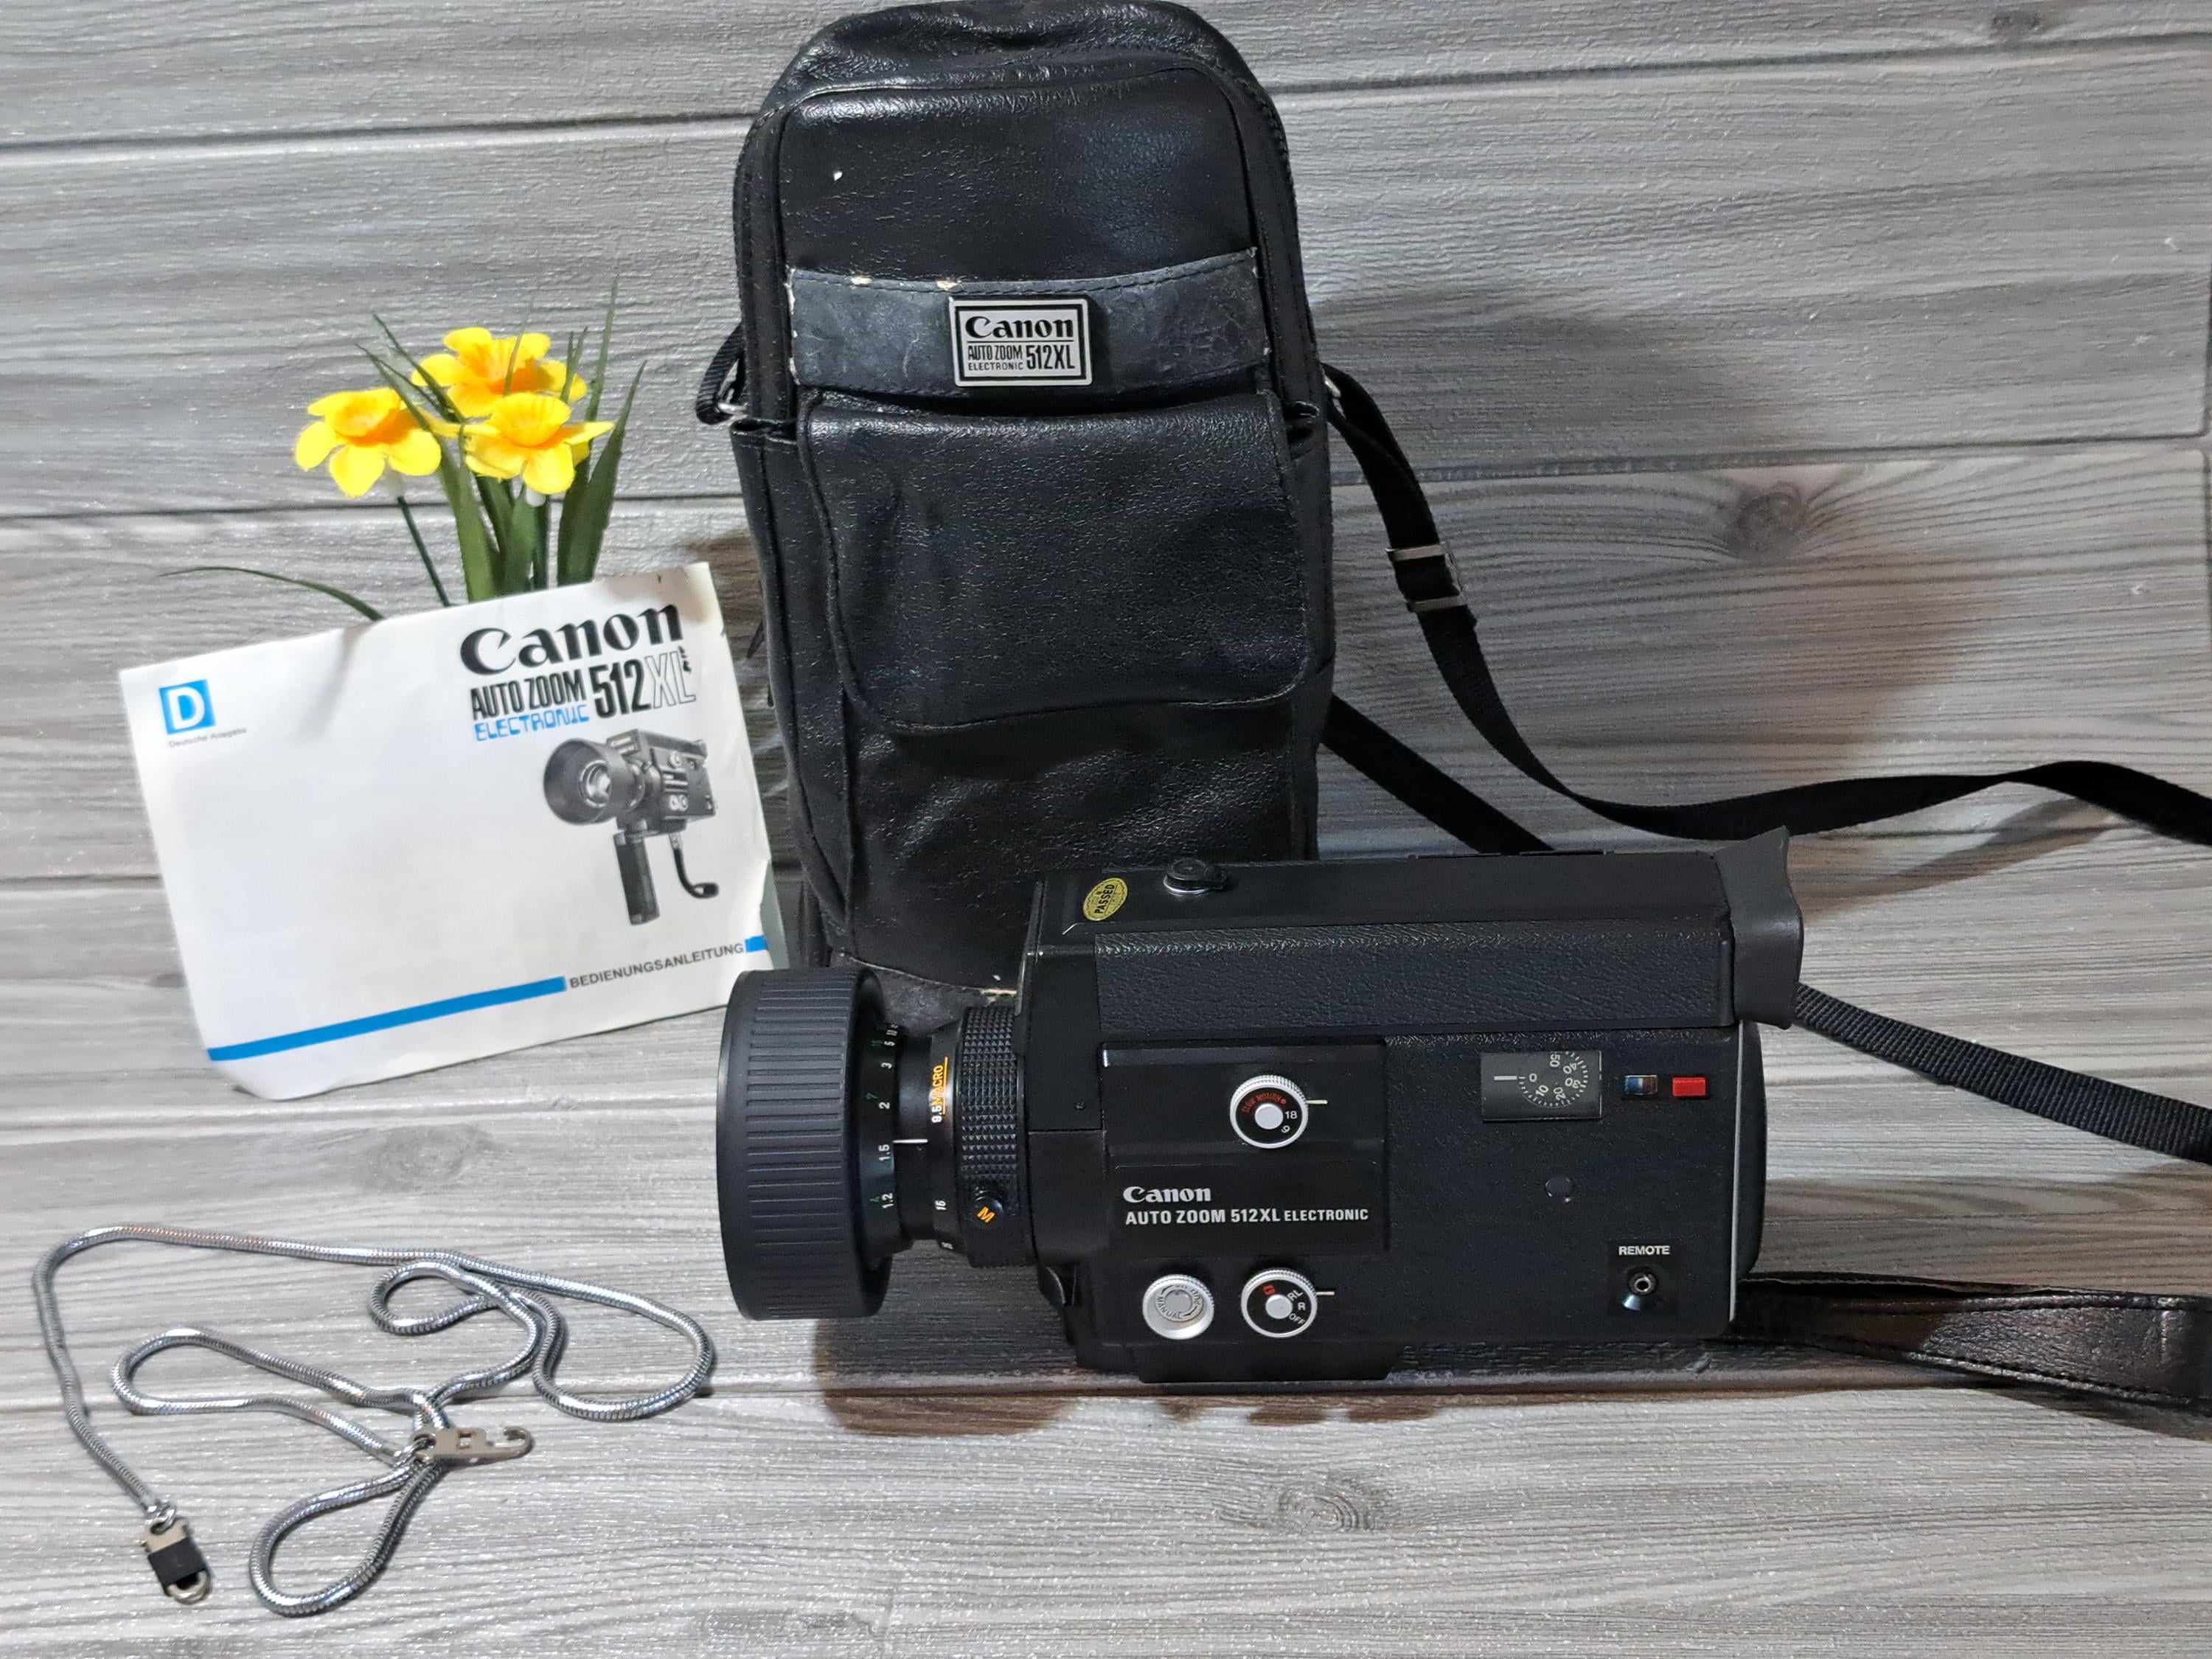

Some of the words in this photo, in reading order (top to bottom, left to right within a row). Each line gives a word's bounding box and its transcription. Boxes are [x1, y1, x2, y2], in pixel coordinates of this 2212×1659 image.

[965, 316, 1074, 339] Canon
[968, 345, 992, 361] AUTO
[995, 345, 1023, 361] ZOOM
[1026, 344, 1075, 370] 512XL
[968, 361, 1023, 371] ELECTRONIC
[460, 604, 684, 676] Canon
[470, 679, 525, 721] AUTO
[524, 668, 587, 710] ZOOM
[167, 686, 206, 731] D
[474, 703, 590, 742] ELECTRONIC
[1094, 884, 1115, 914] PASSED
[569, 942, 745, 989] BEDIENUNGSANLEITUNG
[1549, 1054, 1560, 1068] 50
[1562, 1062, 1576, 1074] 40
[931, 1065, 943, 1105] MACRO
[1528, 1073, 1537, 1082] 0
[1565, 1077, 1581, 1088] 30
[1535, 1085, 1549, 1096] 10
[1553, 1087, 1566, 1101] 20
[879, 1102, 890, 1110] 2
[1285, 1110, 1298, 1119] 18
[1281, 1125, 1290, 1133] 9
[878, 1144, 891, 1161] 1.5
[881, 1192, 894, 1208] 1.2
[1123, 1186, 1211, 1203] Canon
[977, 1206, 995, 1223] M
[1125, 1211, 1172, 1225] AUTO
[1176, 1209, 1226, 1224] ZOOM
[1231, 1208, 1281, 1223] 512XL
[1284, 1208, 1368, 1222] ELECTRONIC
[1618, 1245, 1670, 1256] REMOTE
[1287, 1290, 1304, 1301] RL
[1156, 1295, 1183, 1320] MANUAL
[1298, 1302, 1306, 1310] R
[1289, 1313, 1306, 1324] OFF
